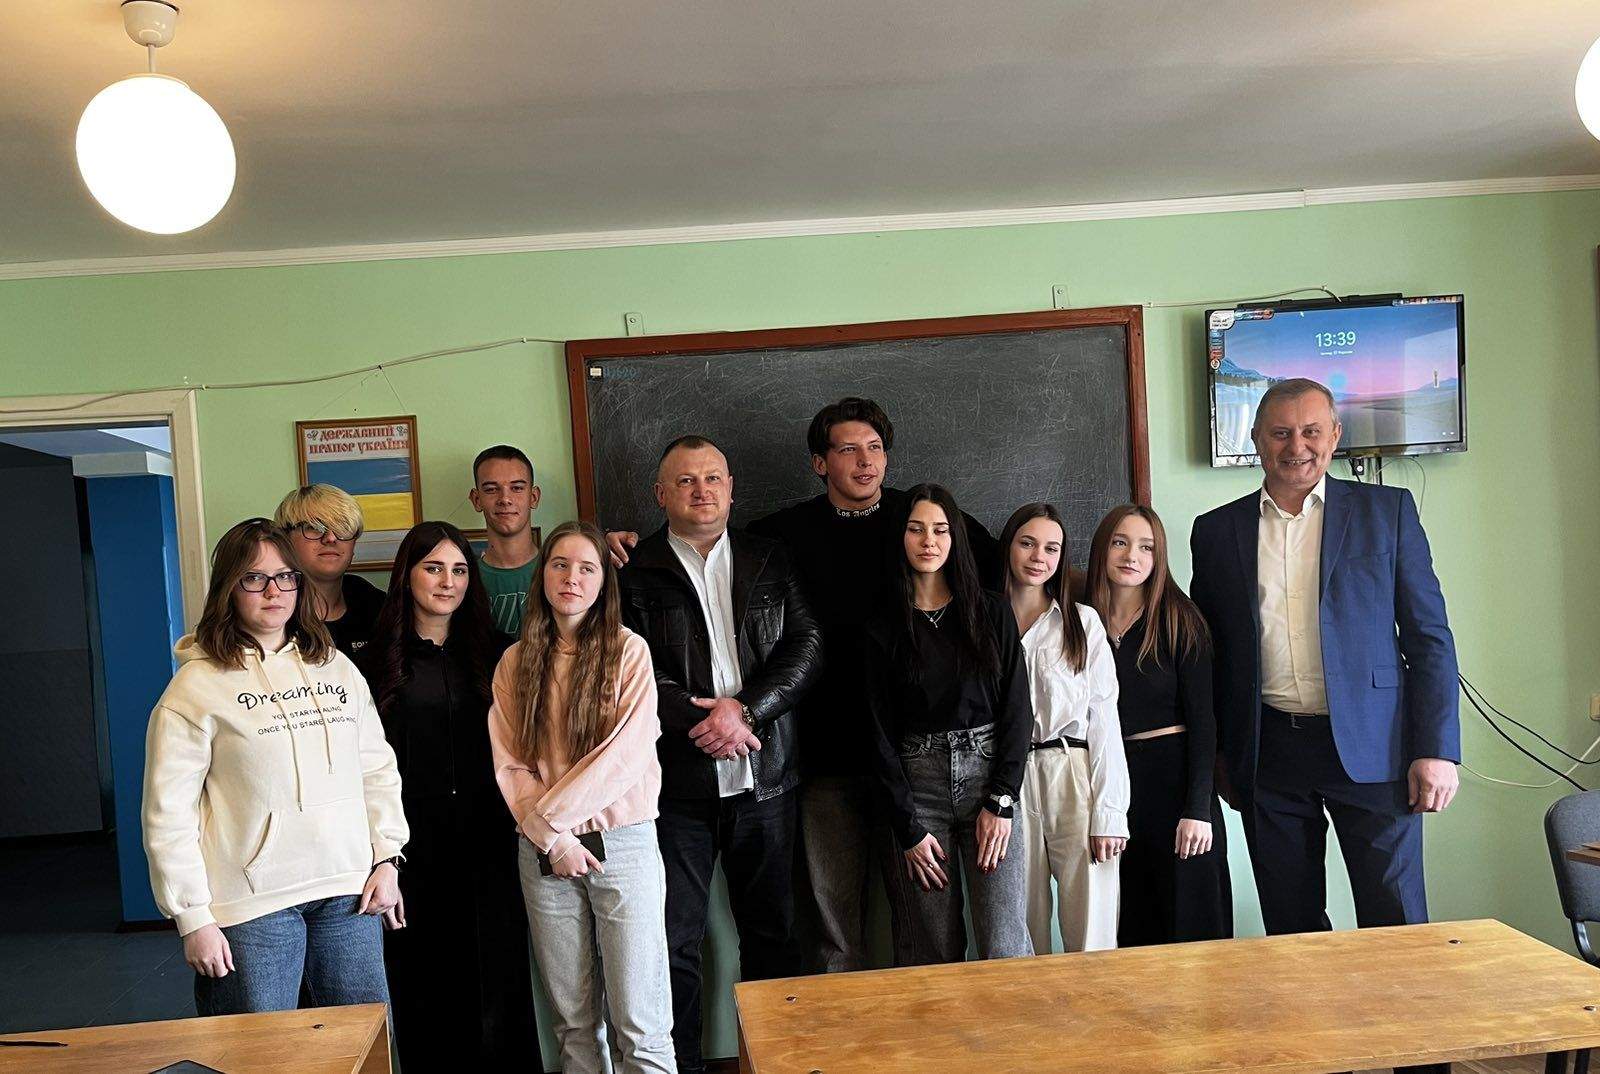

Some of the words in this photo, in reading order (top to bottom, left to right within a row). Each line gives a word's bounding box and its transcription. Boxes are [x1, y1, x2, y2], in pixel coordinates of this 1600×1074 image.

[1315, 331, 1356, 347] 13:39
[320, 424, 394, 442] ДЕРЖАВНИЙ
[309, 442, 355, 454] ПРАПОР
[835, 507, 850, 517] Los
[237, 682, 349, 711] Dreaming
[257, 725, 281, 735] ONCE
